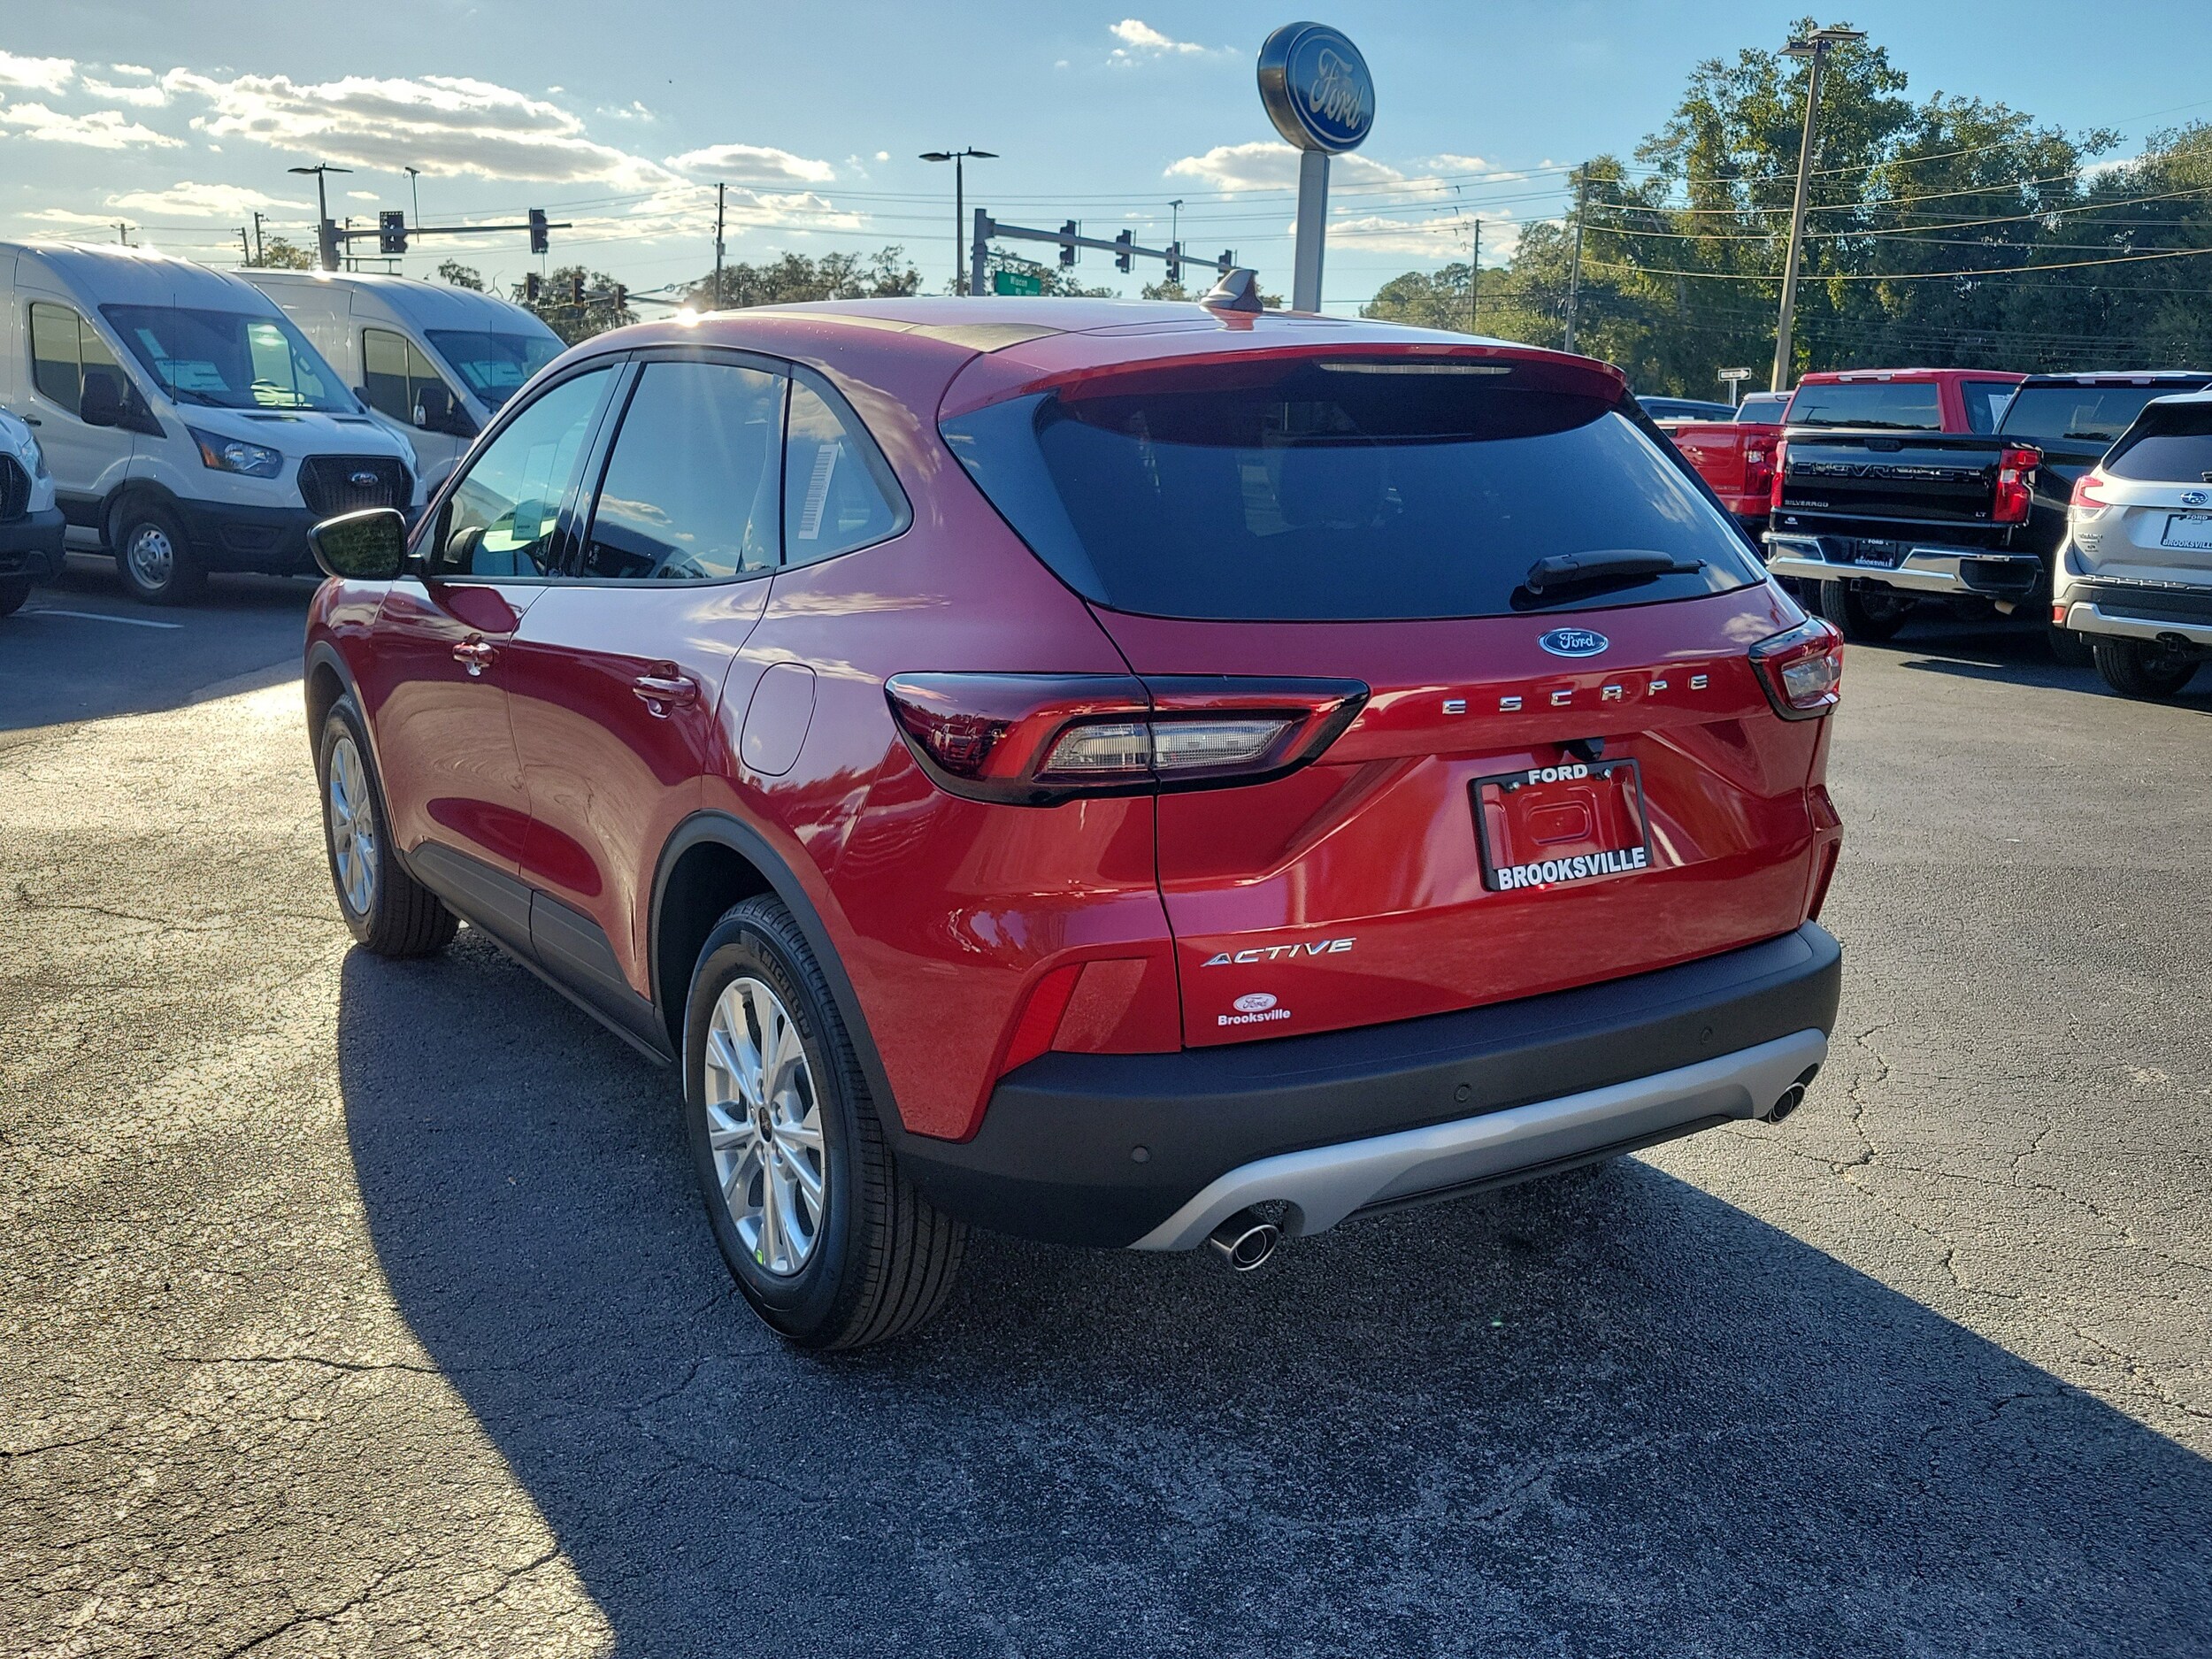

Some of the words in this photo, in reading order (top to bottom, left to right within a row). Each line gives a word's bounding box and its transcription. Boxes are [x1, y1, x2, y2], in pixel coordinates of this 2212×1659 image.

[1309, 48, 1364, 130] Ford
[1784, 499, 1829, 508] SILVERADO
[2162, 539, 2212, 549] BROOKSVILL
[1558, 632, 1595, 650] Ford
[1441, 674, 1709, 715] ESCAPE
[1527, 764, 1589, 786] FORD
[1497, 846, 1647, 891] BROOKSVILLE
[1199, 937, 1357, 968] ACTIVE
[761, 949, 810, 1034] MICHELIN
[1242, 996, 1270, 1010] Ford
[1217, 1009, 1292, 1026] Brooksville
